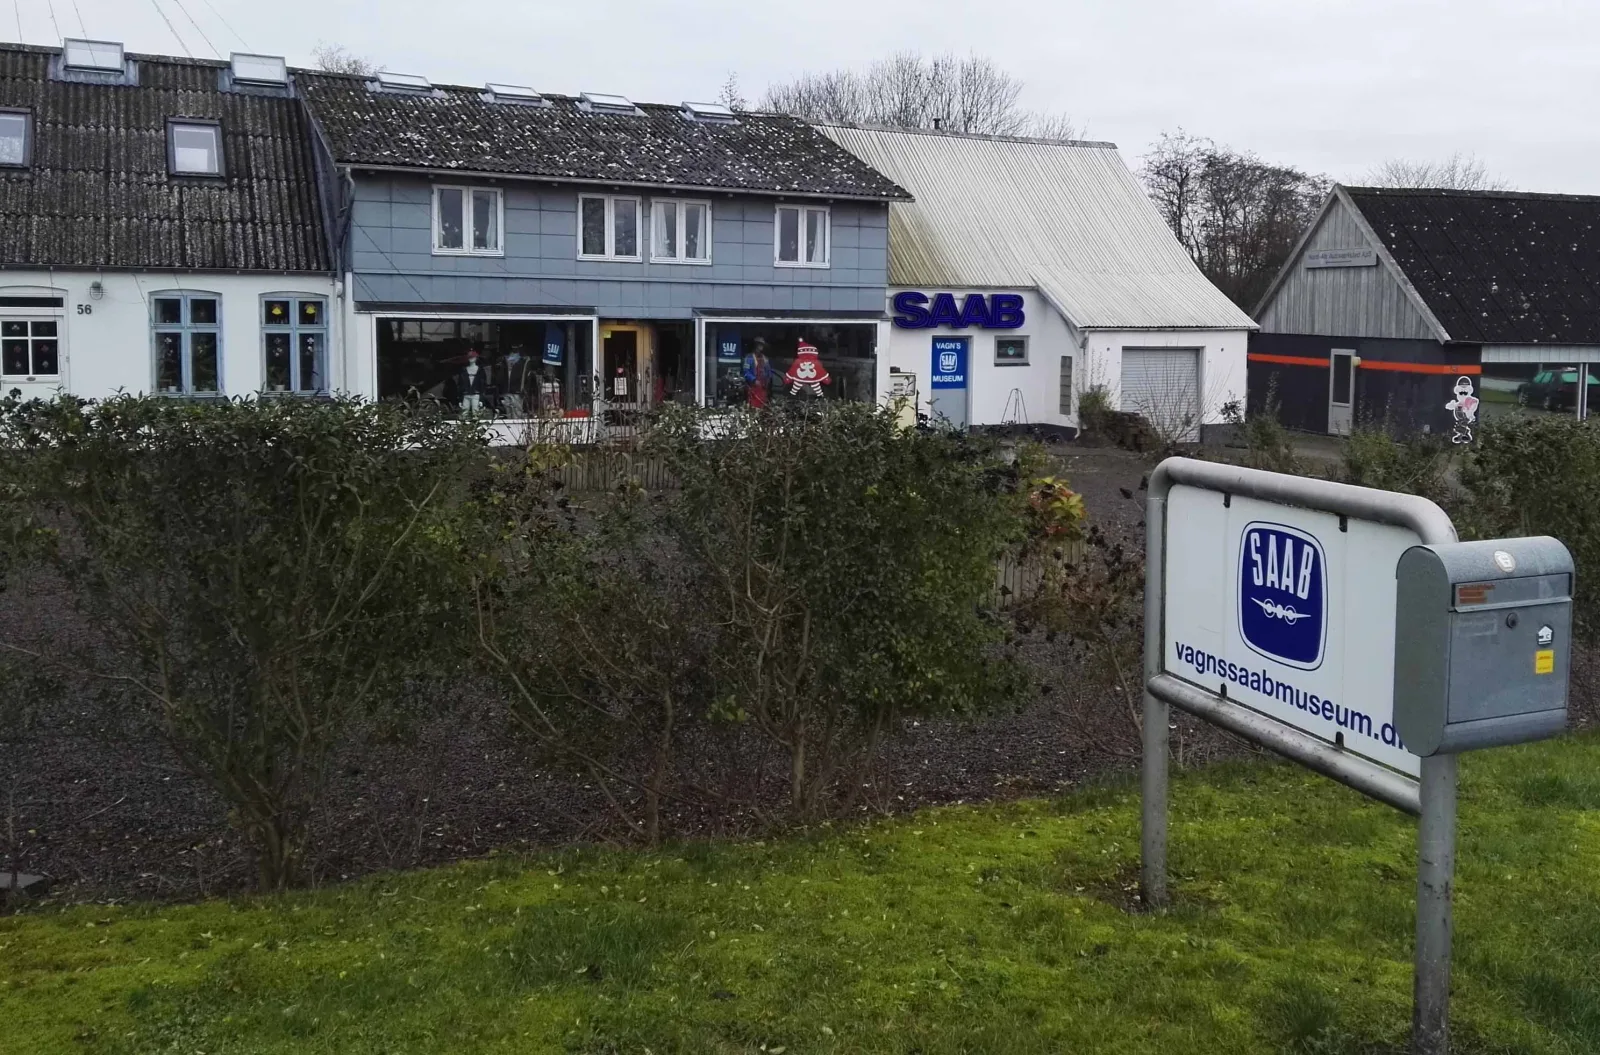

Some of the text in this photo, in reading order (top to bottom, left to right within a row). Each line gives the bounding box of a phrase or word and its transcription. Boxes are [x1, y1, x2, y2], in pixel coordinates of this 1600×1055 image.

[77, 304, 92, 315] 56
[893, 291, 1025, 329] SAAB
[941, 354, 956, 366] SAAB
[932, 375, 963, 383] MUSEUM
[1250, 532, 1315, 600] SAAB
[1175, 641, 1404, 751] vagnssaabmuseum.d
